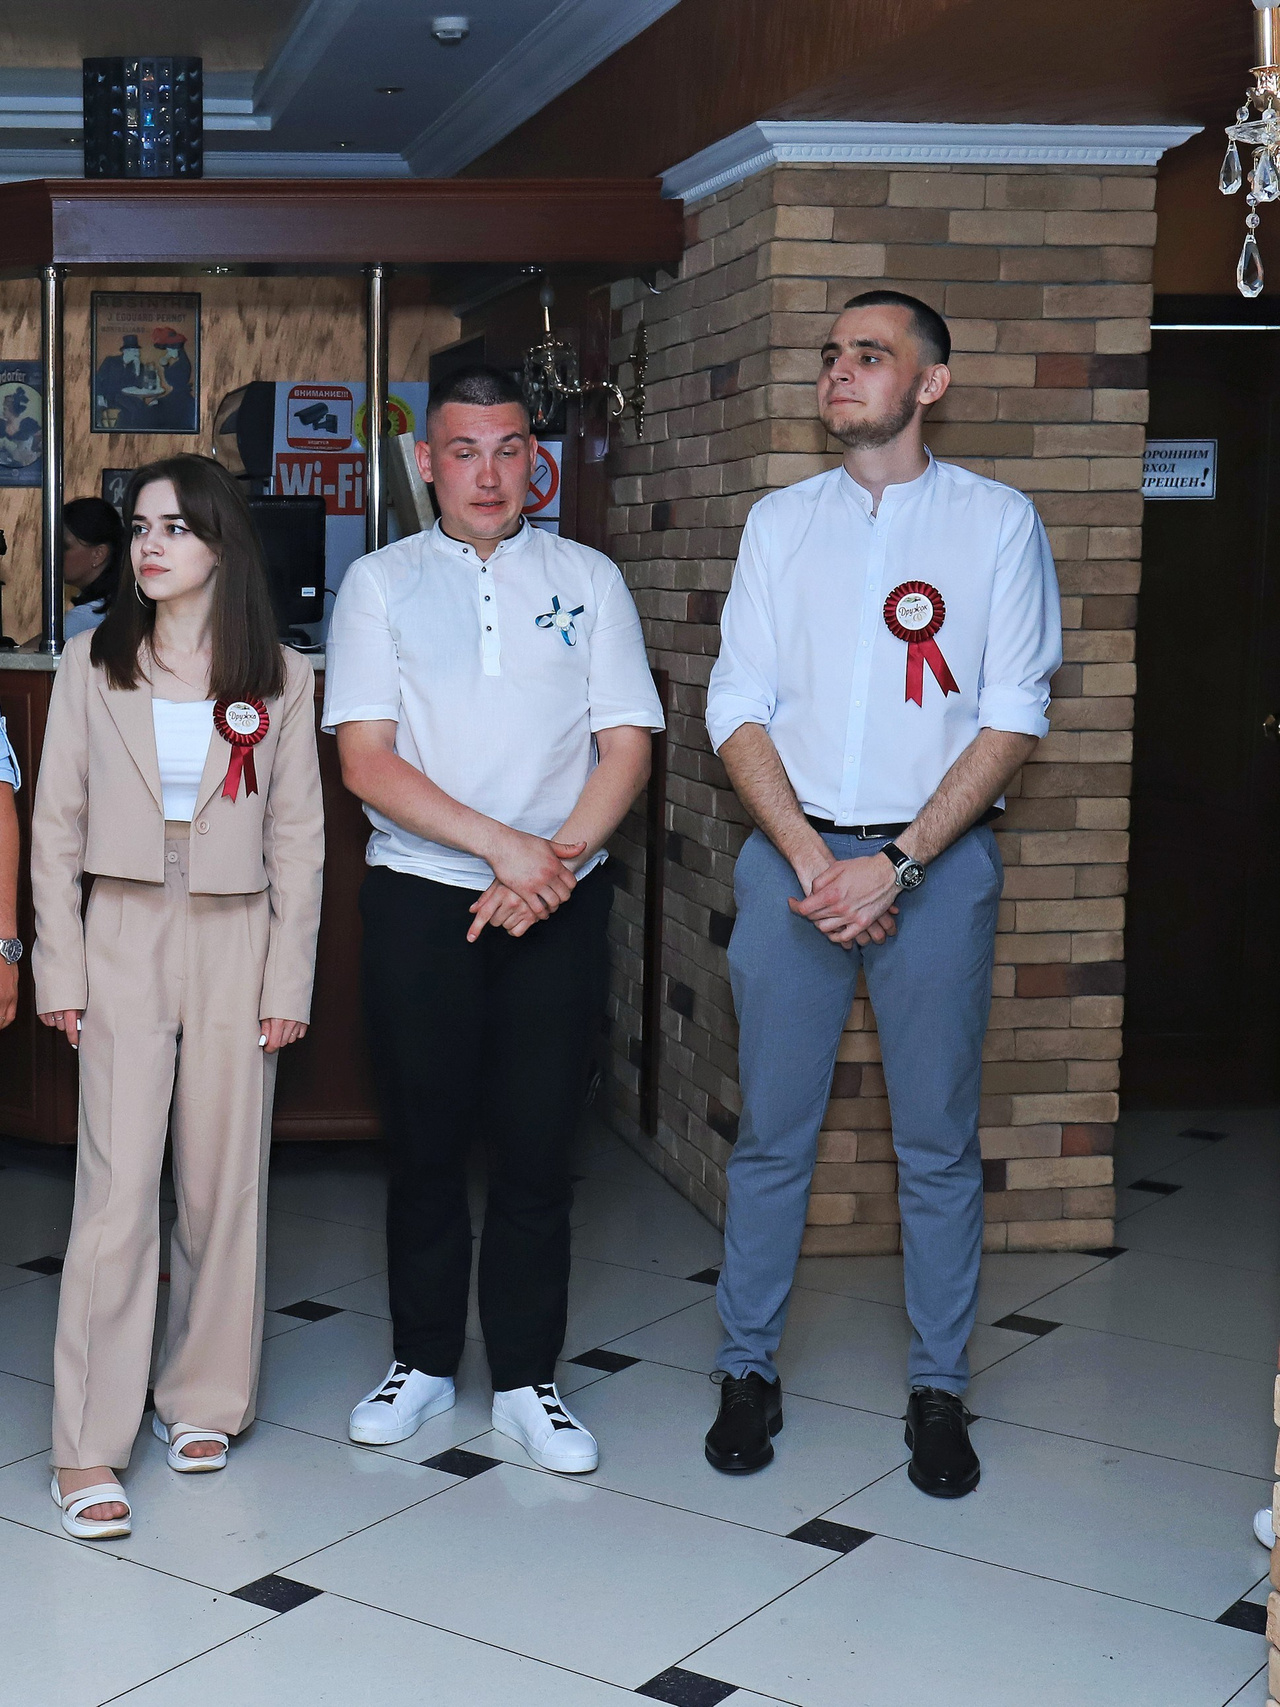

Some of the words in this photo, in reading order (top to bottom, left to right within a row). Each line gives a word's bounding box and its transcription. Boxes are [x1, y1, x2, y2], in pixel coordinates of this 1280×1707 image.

[294, 389, 349, 398] ВНИМАНИЕ!!!
[1142, 463, 1176, 473] ВХОД
[280, 461, 363, 508] Wi-Fi
